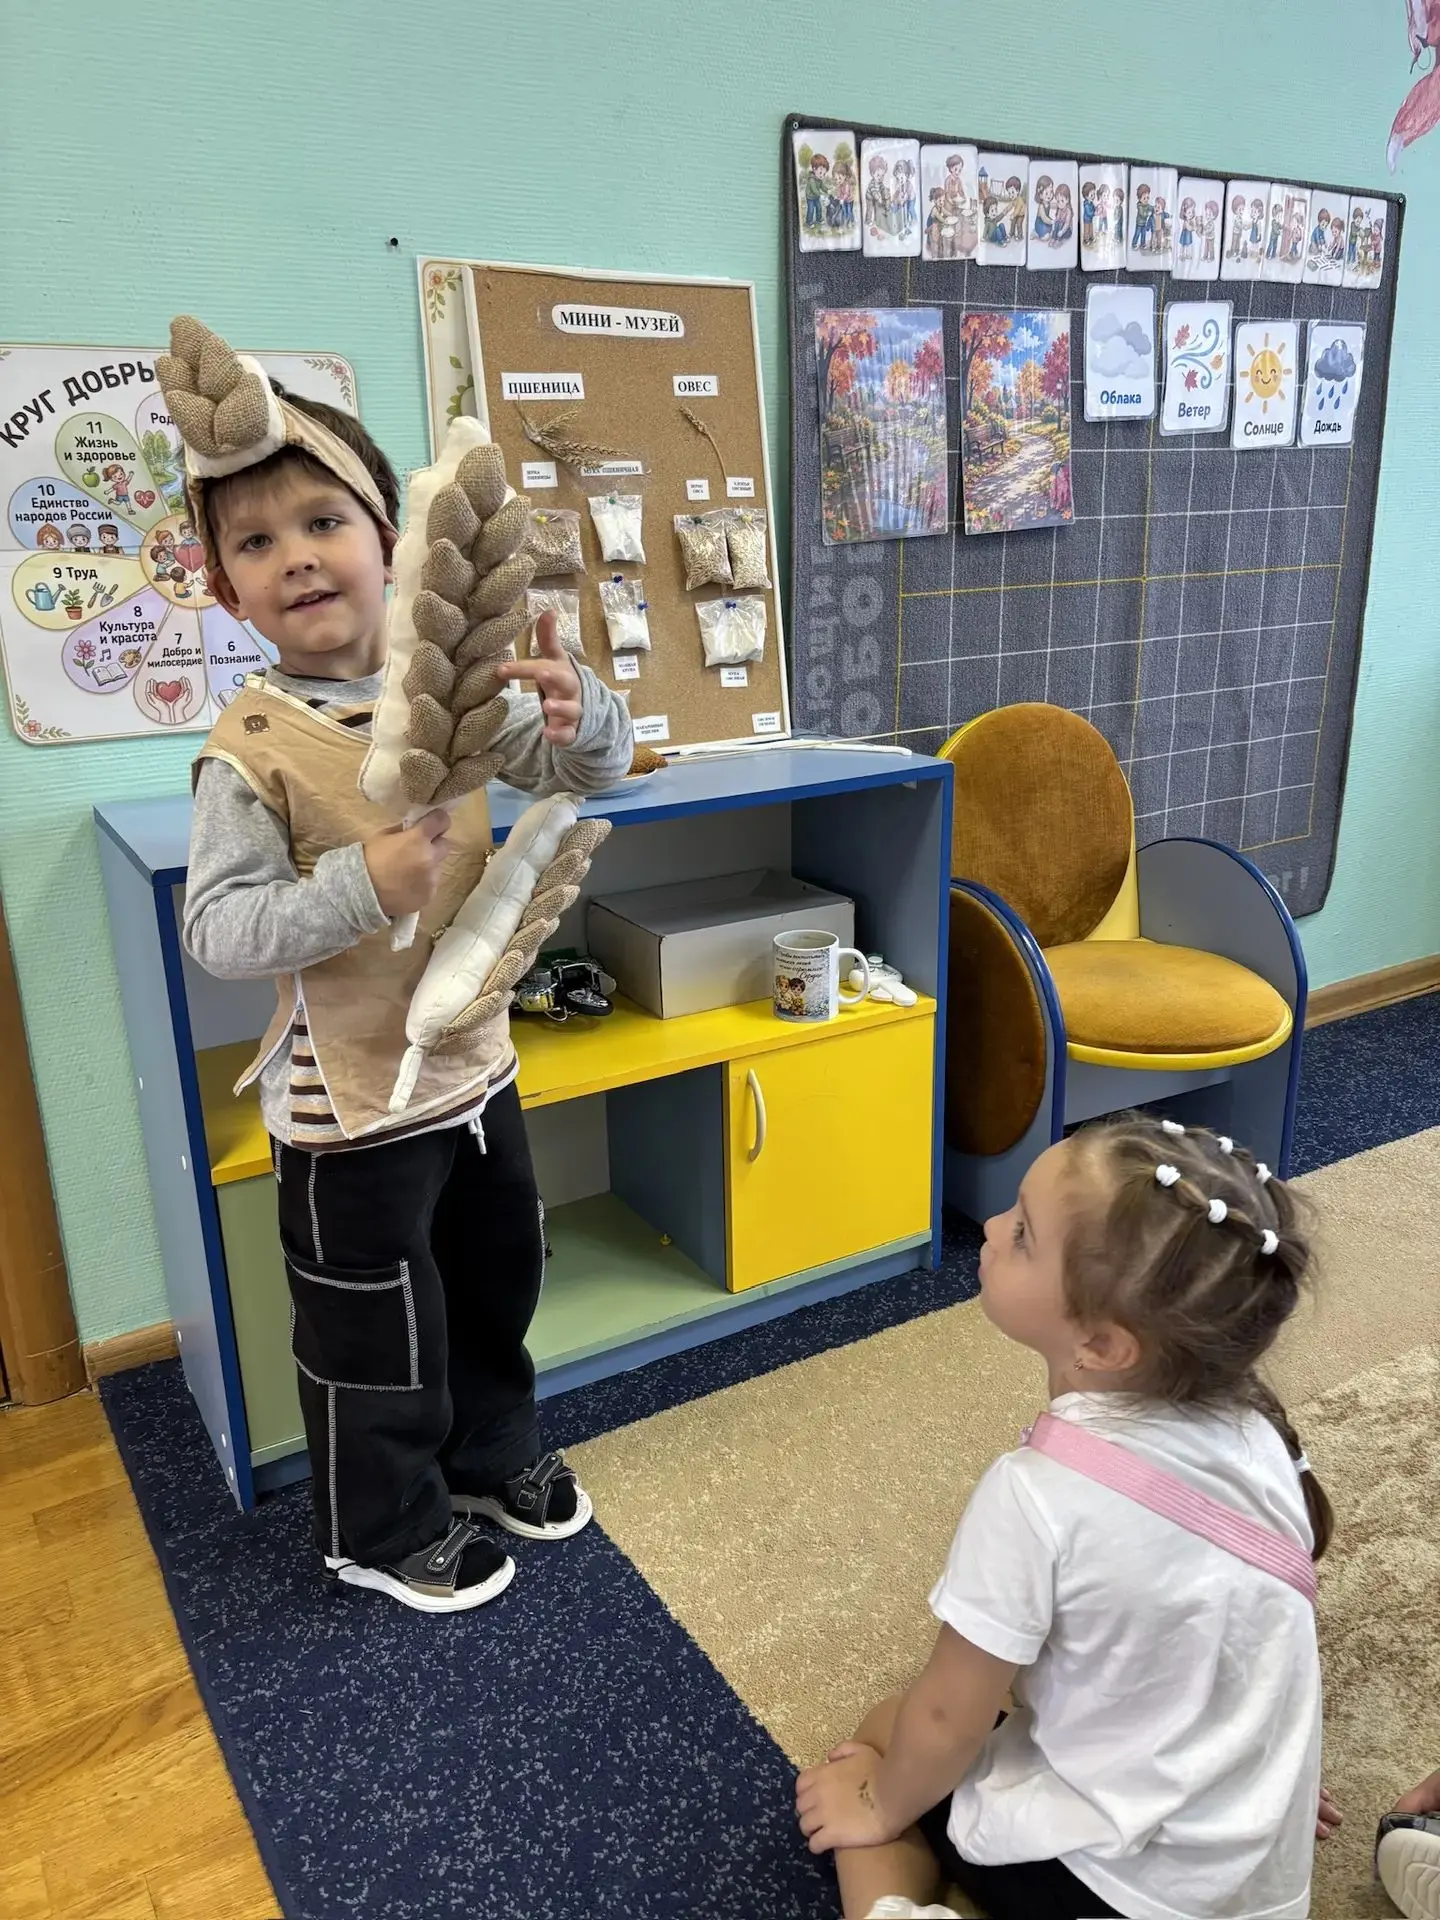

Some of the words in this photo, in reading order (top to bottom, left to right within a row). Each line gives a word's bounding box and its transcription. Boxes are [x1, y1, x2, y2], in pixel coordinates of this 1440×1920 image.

[559, 311, 611, 328] МИНИ
[625, 315, 679, 333] МУЗЕЙ
[508, 382, 581, 396] ПШЕНИЦА
[677, 380, 712, 392] ОВЕС
[1100, 390, 1142, 405] Облака
[1177, 402, 1211, 420] Ветер
[0, 389, 56, 449] КРУГ
[150, 412, 175, 426] Род
[86, 421, 103, 434] 11
[1243, 420, 1285, 437] Солнце
[1313, 419, 1343, 433] Дождь
[74, 436, 118, 448] Жизнь
[64, 452, 73, 461] и
[76, 452, 136, 463] здоровье
[38, 484, 55, 497] 10
[31, 498, 89, 510] Единство
[15, 512, 67, 523] народов
[70, 509, 113, 520] России
[53, 567, 62, 579] 9
[66, 566, 98, 579] Труд
[133, 605, 143, 617] 8
[99, 620, 155, 634] Культура
[99, 635, 108, 645] и
[111, 632, 158, 646] красота
[174, 633, 183, 645] 7
[162, 647, 193, 657] Добро
[195, 647, 202, 655] и
[227, 641, 236, 652] 6
[147, 657, 203, 668] милосердие
[210, 654, 261, 665] Познание
